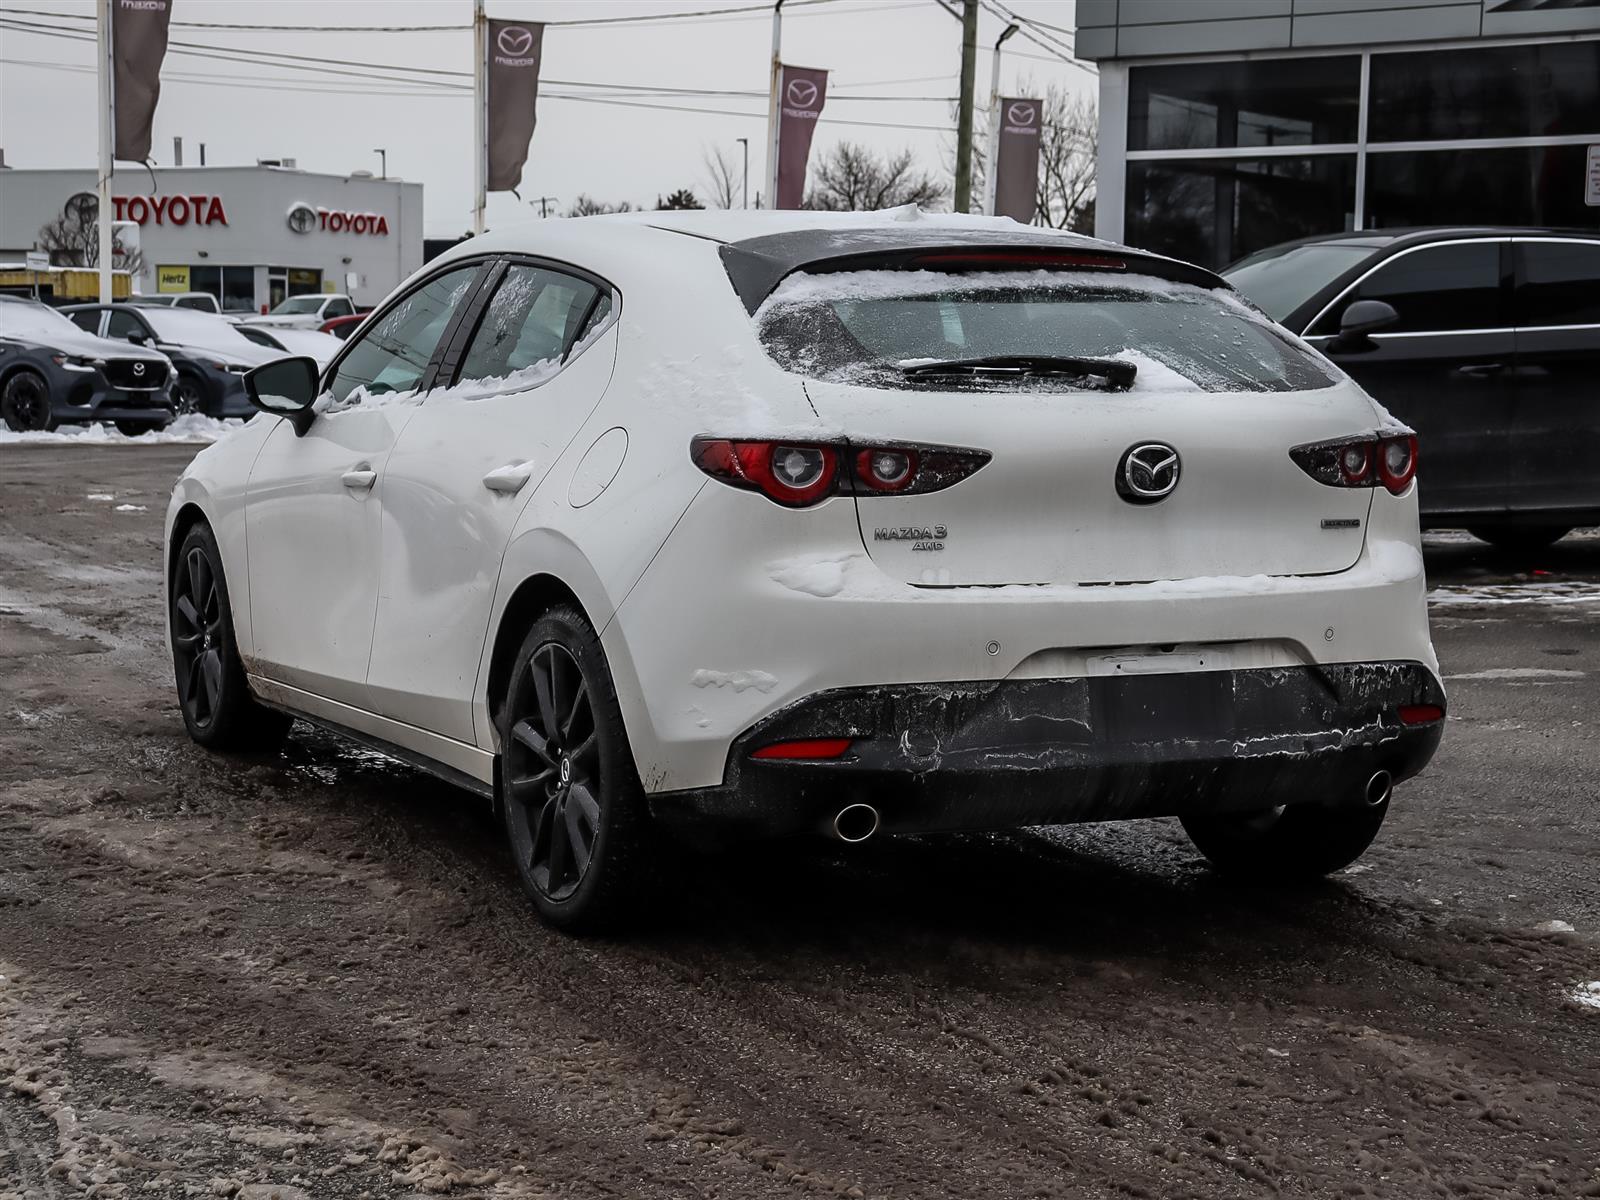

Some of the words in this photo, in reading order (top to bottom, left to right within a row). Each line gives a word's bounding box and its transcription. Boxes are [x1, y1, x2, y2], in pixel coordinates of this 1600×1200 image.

[111, 195, 228, 226] TOYOTA
[318, 210, 388, 236] TOYOTA
[162, 272, 186, 284] Hertz
[912, 541, 945, 552] AWD
